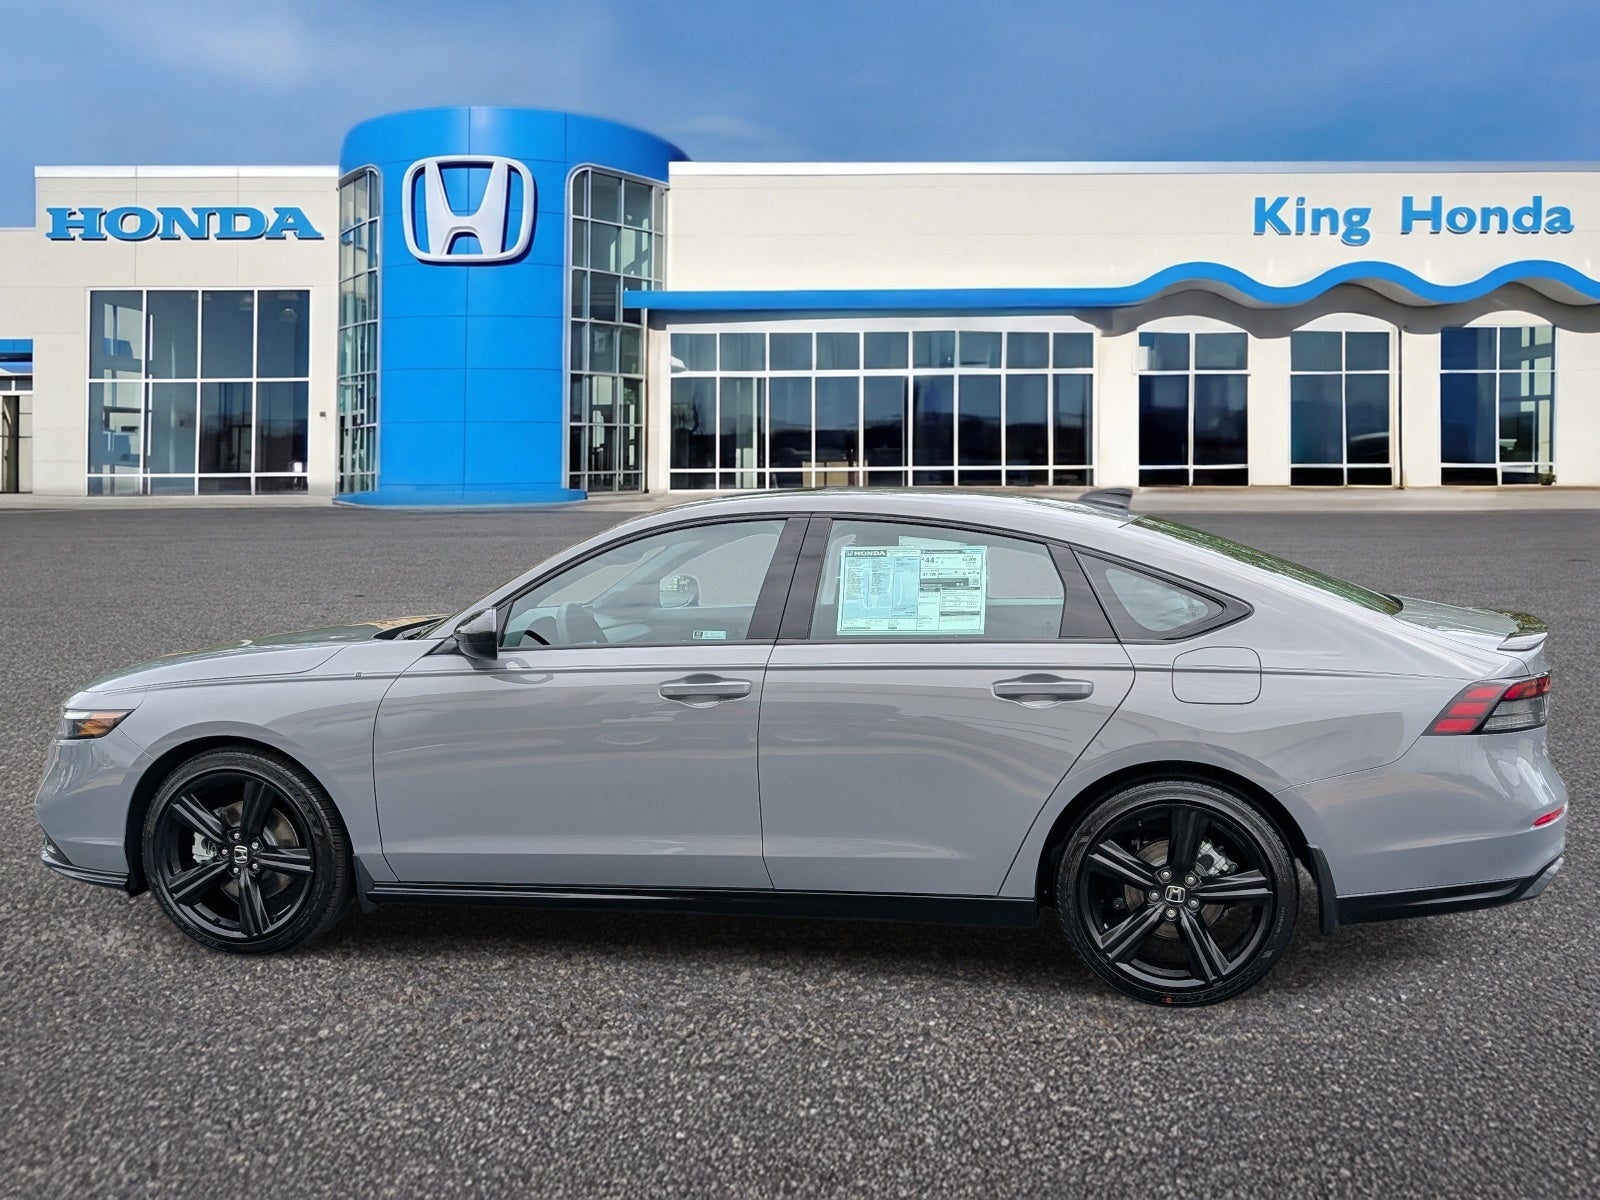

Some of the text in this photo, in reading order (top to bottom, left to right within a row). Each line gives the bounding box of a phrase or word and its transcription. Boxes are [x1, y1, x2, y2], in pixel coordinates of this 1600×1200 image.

[45, 206, 325, 241] HONDA
[1253, 195, 1575, 246] King Honda
